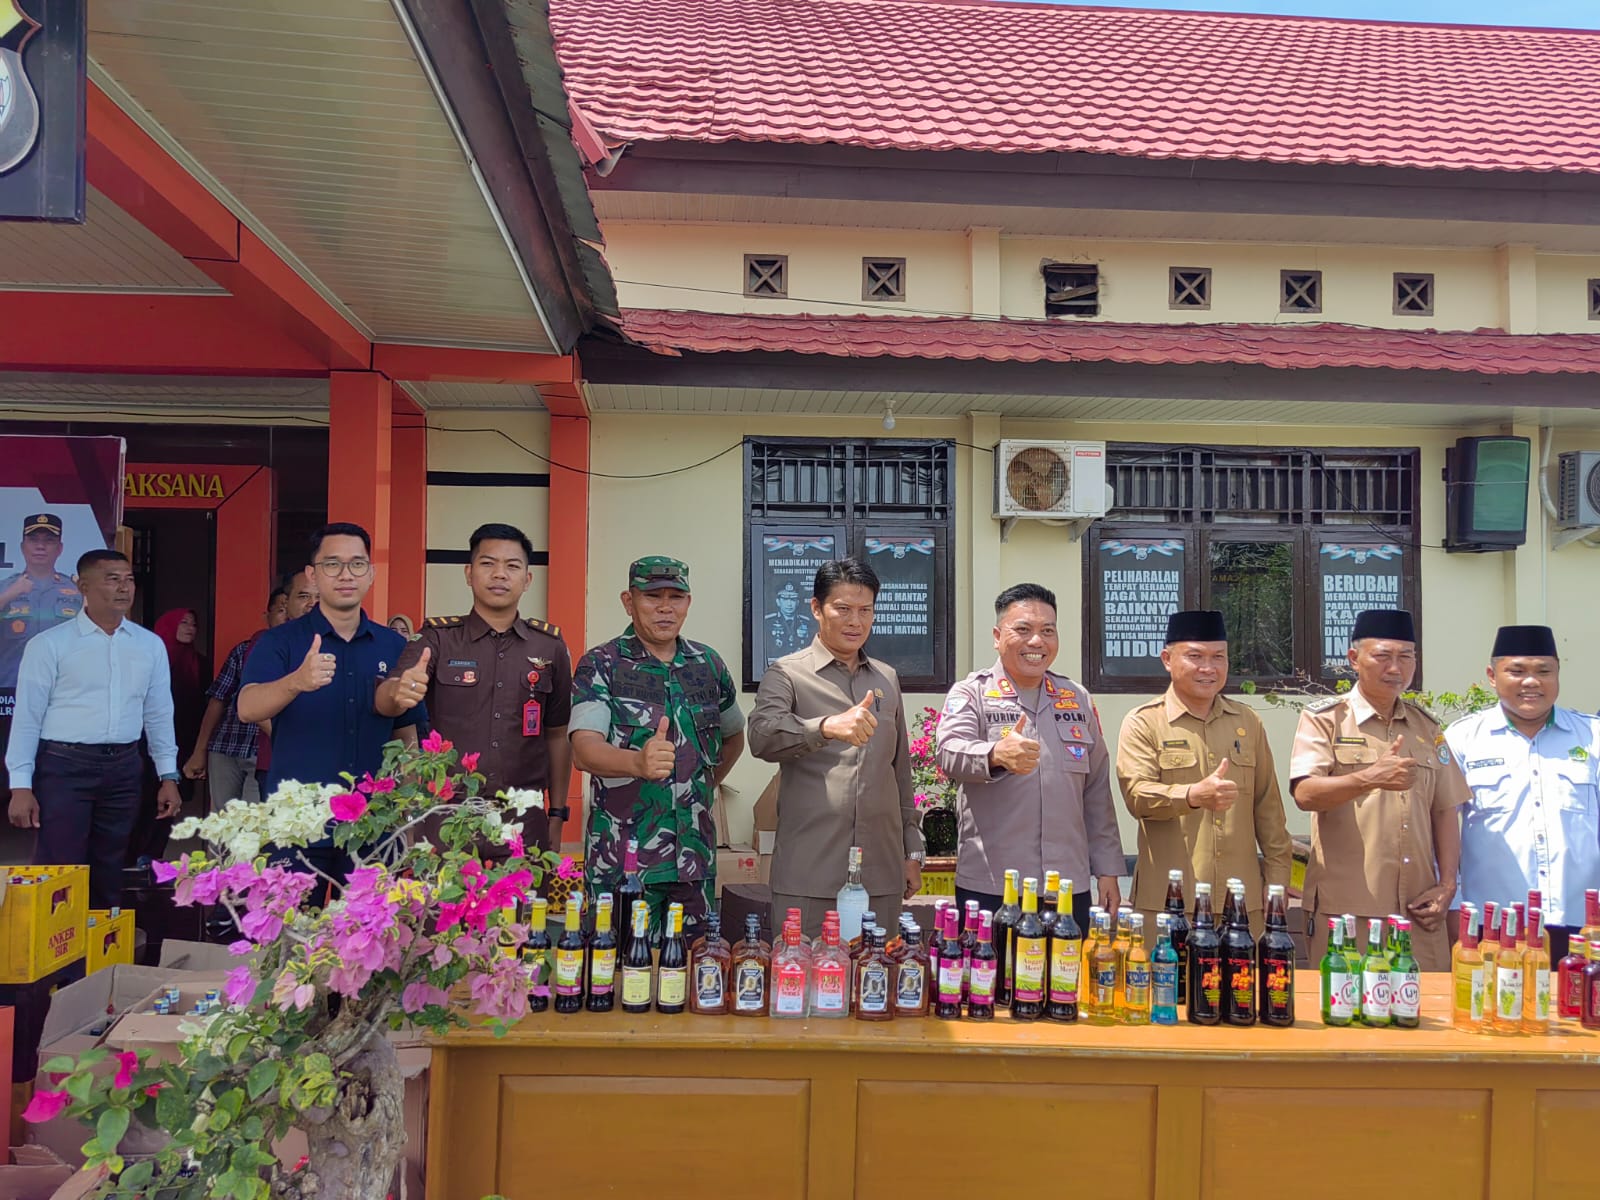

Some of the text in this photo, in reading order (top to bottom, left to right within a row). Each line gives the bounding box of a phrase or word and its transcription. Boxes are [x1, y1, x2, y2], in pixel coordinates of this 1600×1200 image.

[124, 473, 225, 498] AKSANA
[1104, 571, 1179, 583] PELIHARALAH
[1324, 575, 1398, 592] BERUBAH
[894, 592, 928, 601] MANTAP
[1104, 591, 1179, 601] JAGA NAMA
[1324, 593, 1398, 602] MEMANG BERAT
[1105, 603, 1179, 615] BAIKNYA
[1325, 602, 1398, 611] PADA AWALNYA
[872, 625, 928, 635] YANG MATANG
[1325, 626, 1348, 636] DAN
[1055, 712, 1087, 723] POLRI
[48, 928, 75, 949] ANKER
[55, 943, 69, 958] BIR
